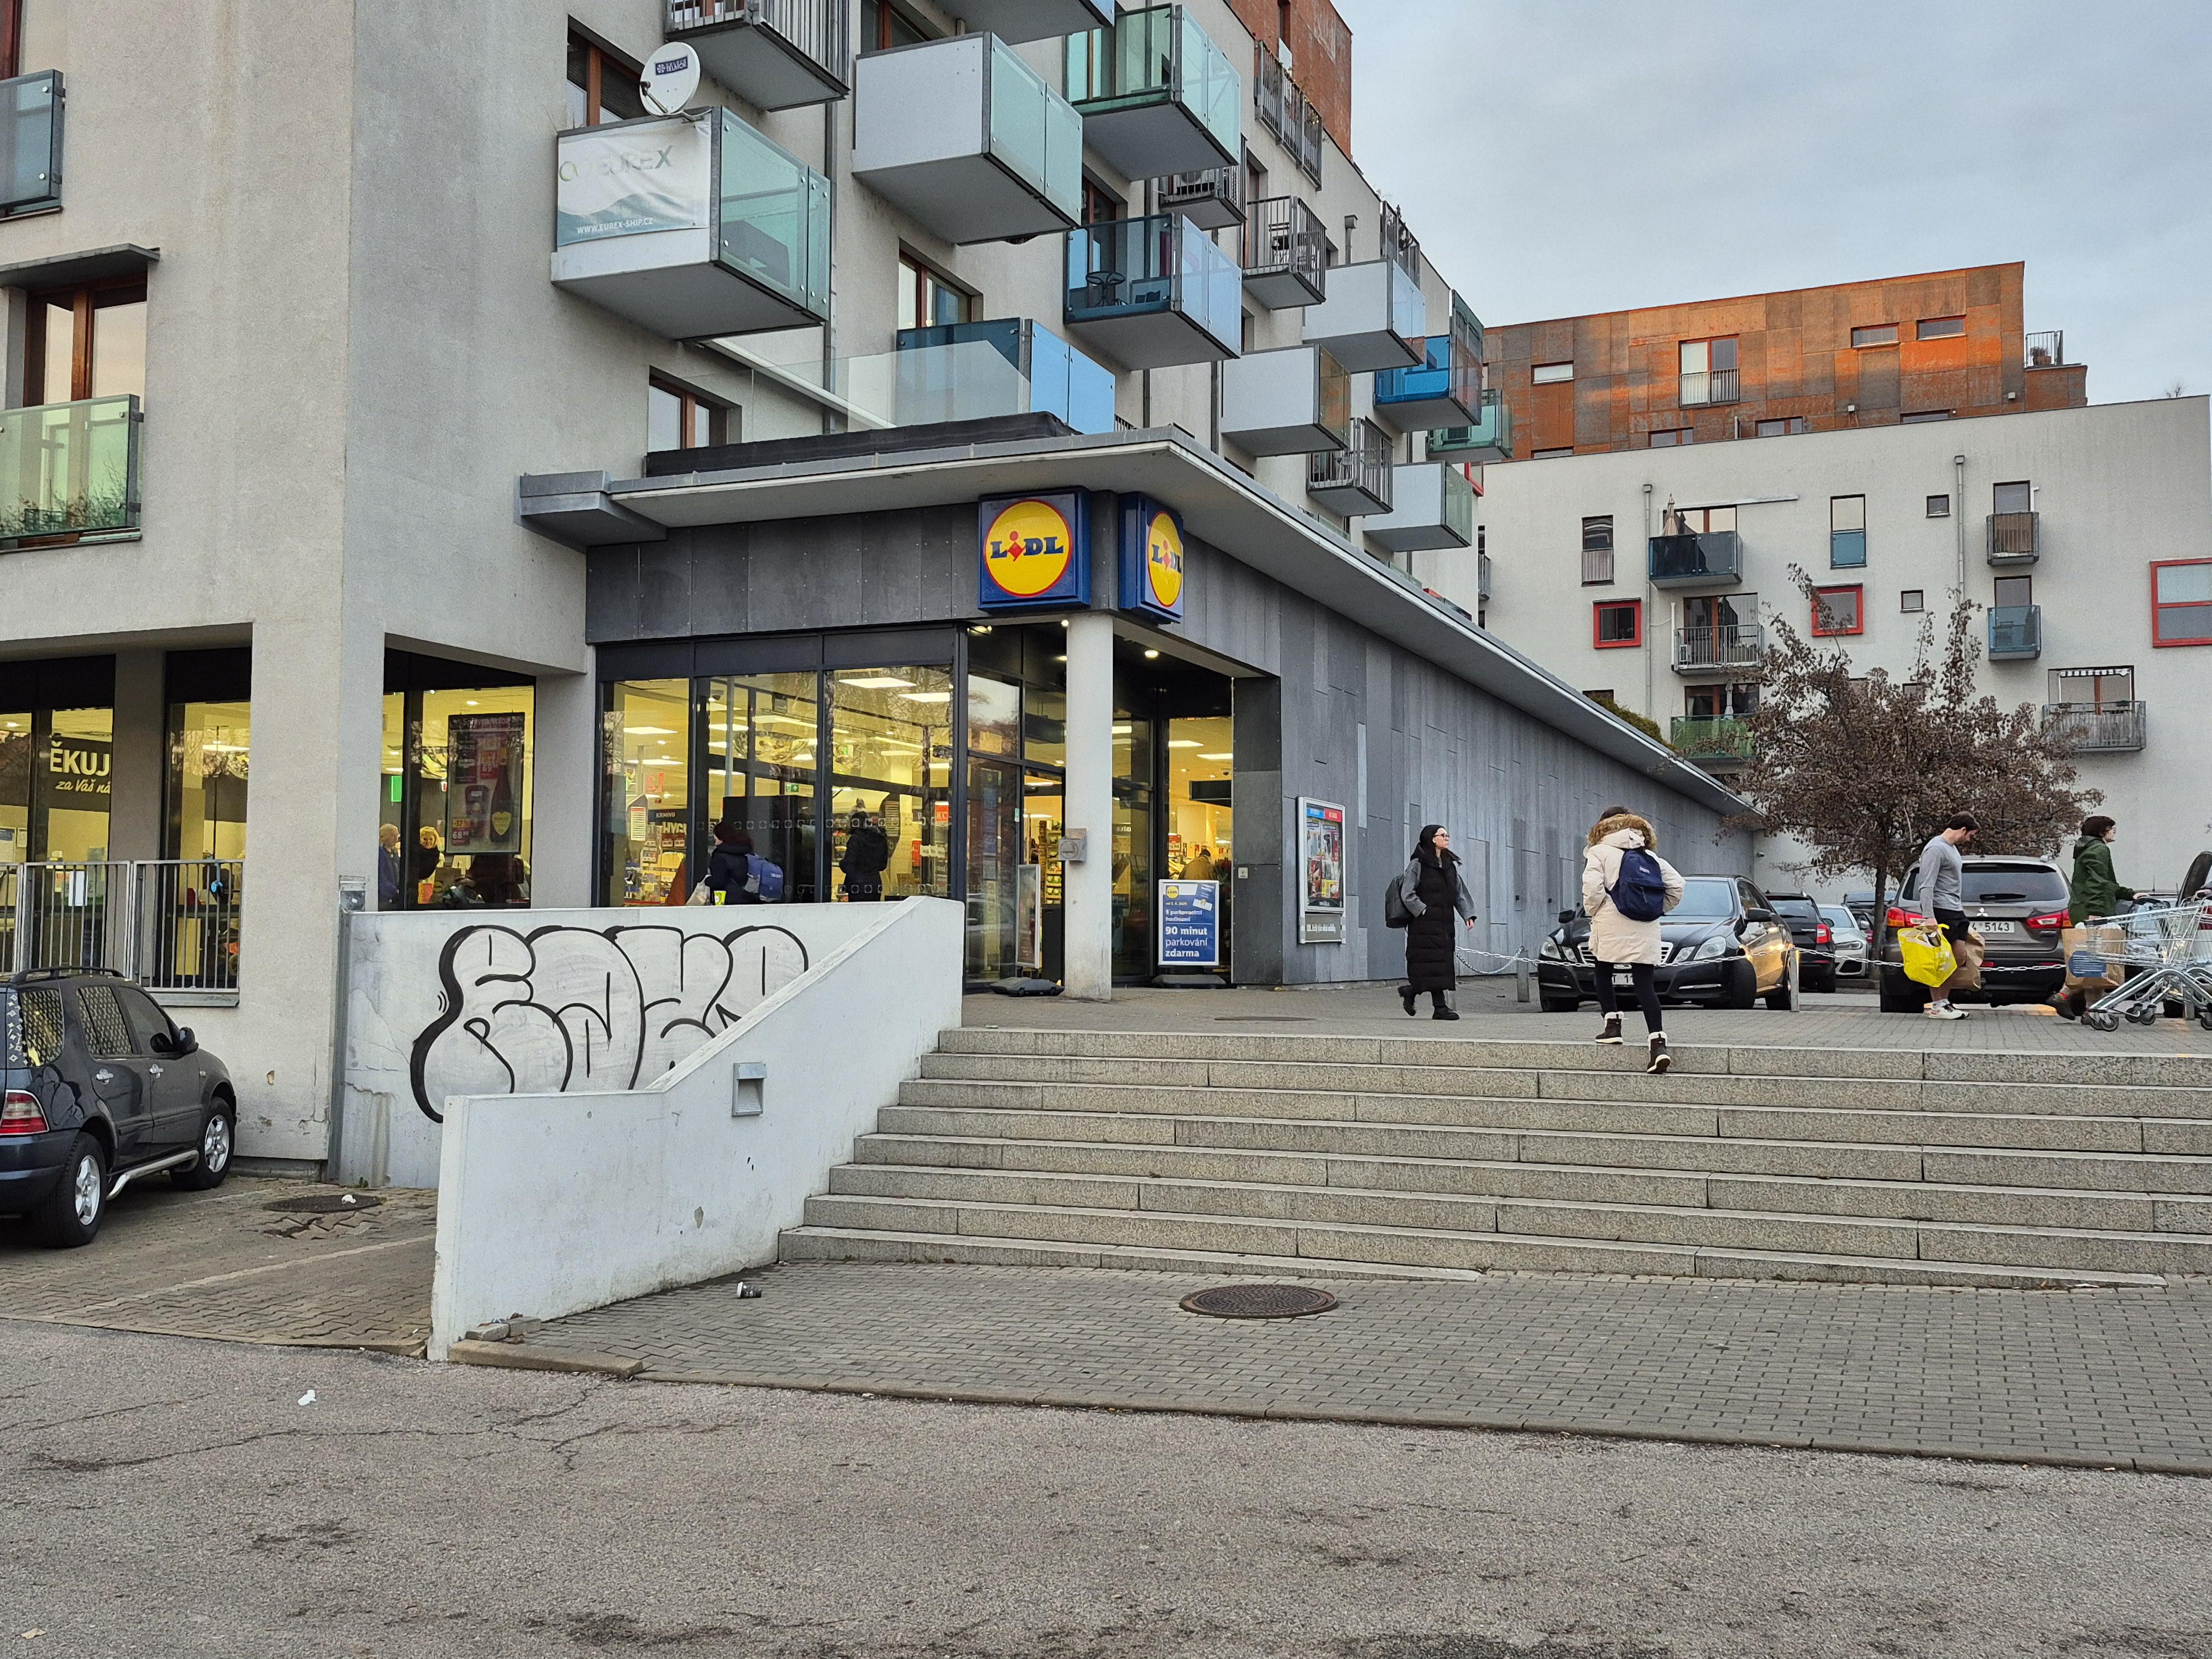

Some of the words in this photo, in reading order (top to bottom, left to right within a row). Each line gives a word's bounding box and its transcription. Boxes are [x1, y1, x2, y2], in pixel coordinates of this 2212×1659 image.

[577, 217, 654, 234] WWW.EUREX-SHIP.CZ
[50, 740, 110, 776] ĚKUJ
[55, 781, 74, 791] za
[75, 779, 97, 792] Váš
[1165, 926, 1178, 935] 90
[1180, 926, 1208, 936] minut
[1984, 922, 2010, 931] 5143
[1165, 937, 1208, 948] parkování
[1165, 948, 1200, 957] zdarma
